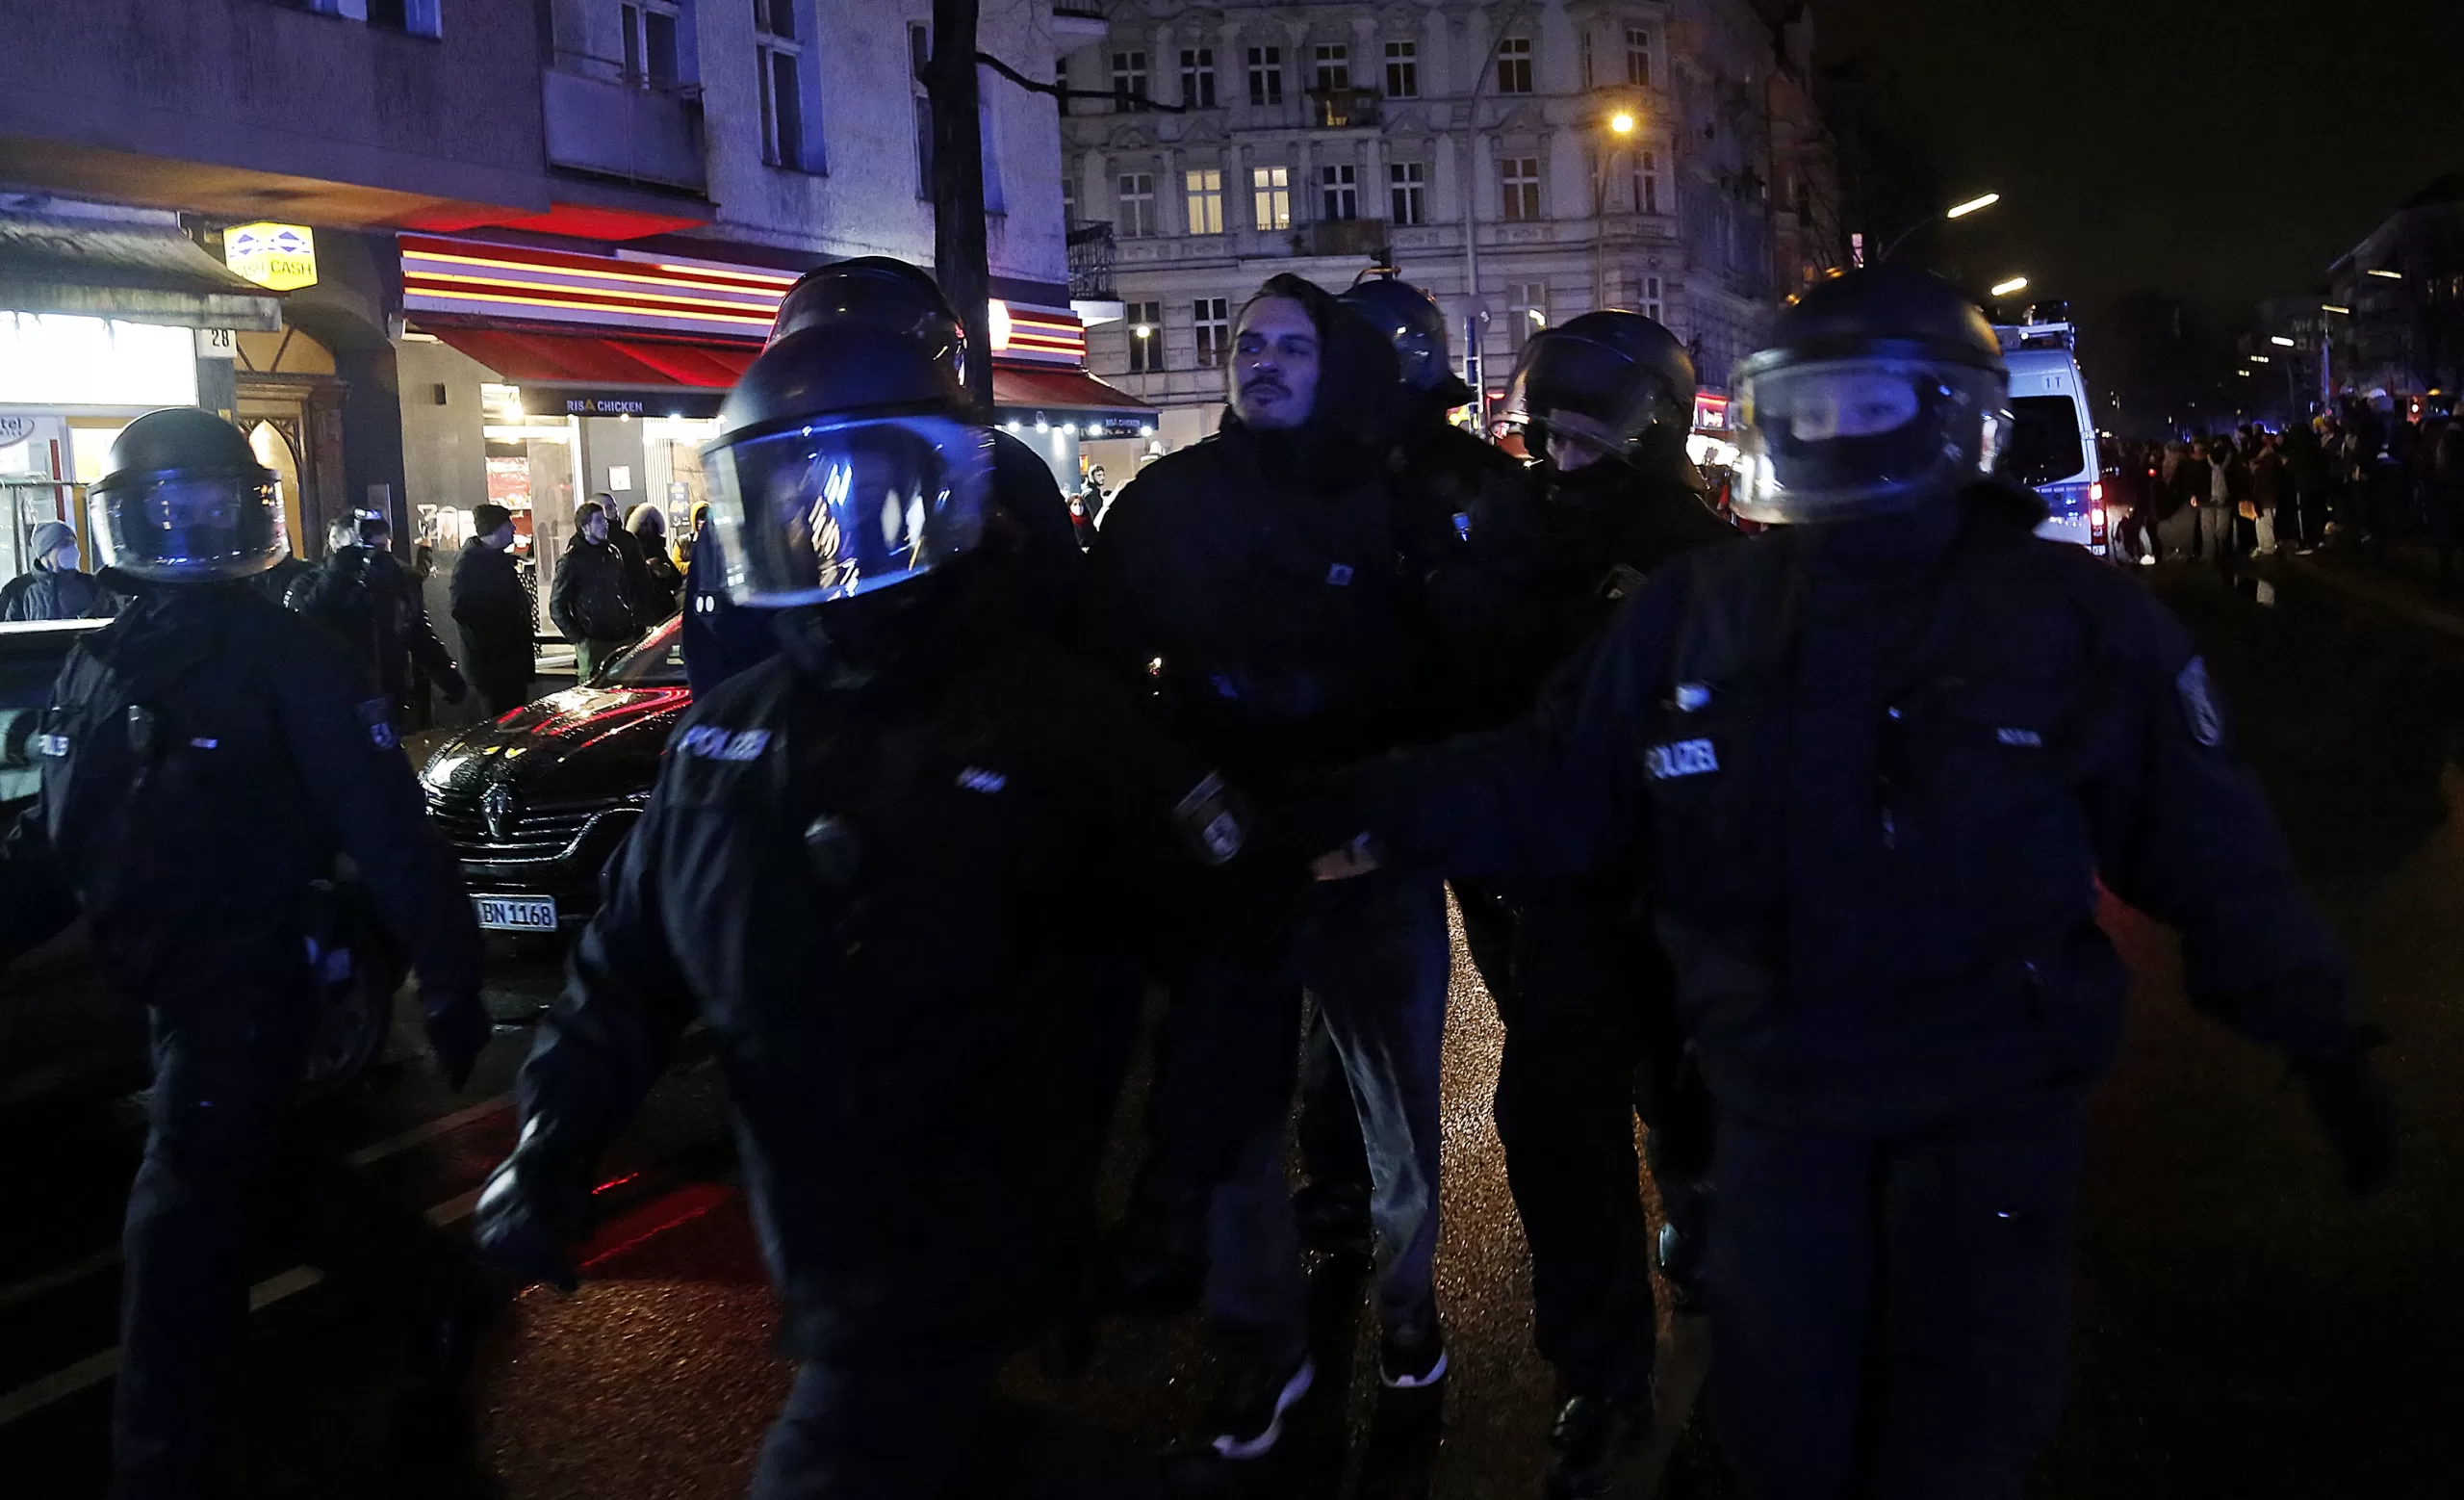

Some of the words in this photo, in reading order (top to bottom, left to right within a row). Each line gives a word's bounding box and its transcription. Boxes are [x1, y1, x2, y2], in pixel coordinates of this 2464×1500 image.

[270, 259, 313, 276] CASH
[212, 328, 229, 348] 28
[597, 400, 644, 413] CHICKEN
